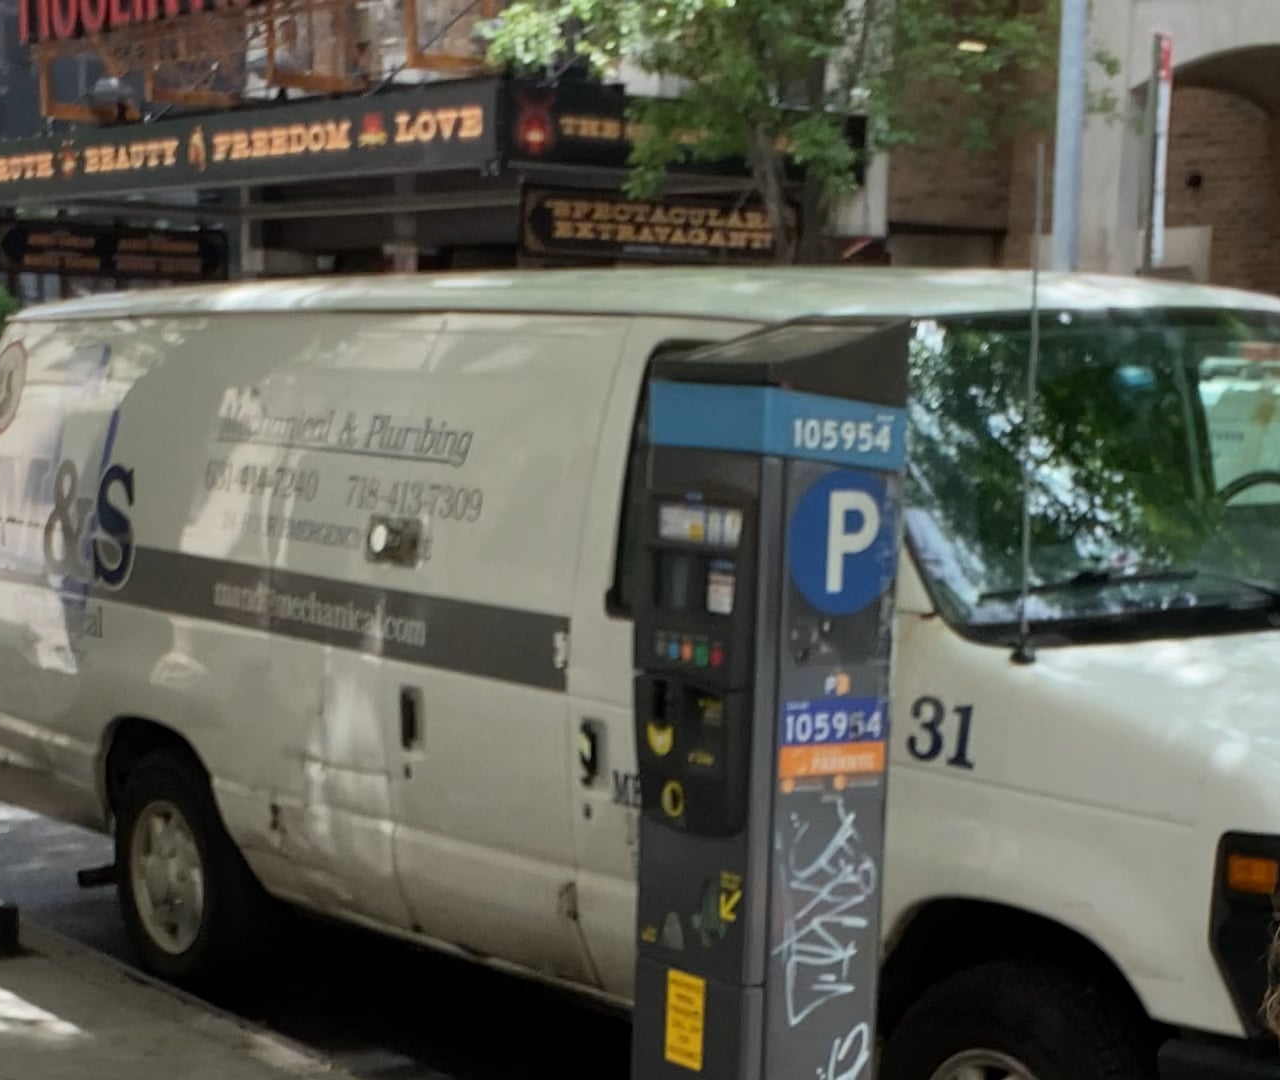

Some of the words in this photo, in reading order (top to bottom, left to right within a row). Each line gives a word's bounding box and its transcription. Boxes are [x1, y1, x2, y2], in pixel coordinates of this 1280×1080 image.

[83, 138, 179, 174] BEAUTY
[212, 118, 353, 163] FREEDOM
[393, 104, 484, 144] LOVE
[559, 113, 622, 139] THE
[363, 413, 475, 468] Plumbing
[793, 418, 893, 453] 105954
[344, 475, 485, 523] 718-413-7309
[826, 490, 881, 594] P
[785, 710, 884, 743] 105954
[906, 696, 975, 771] 31
